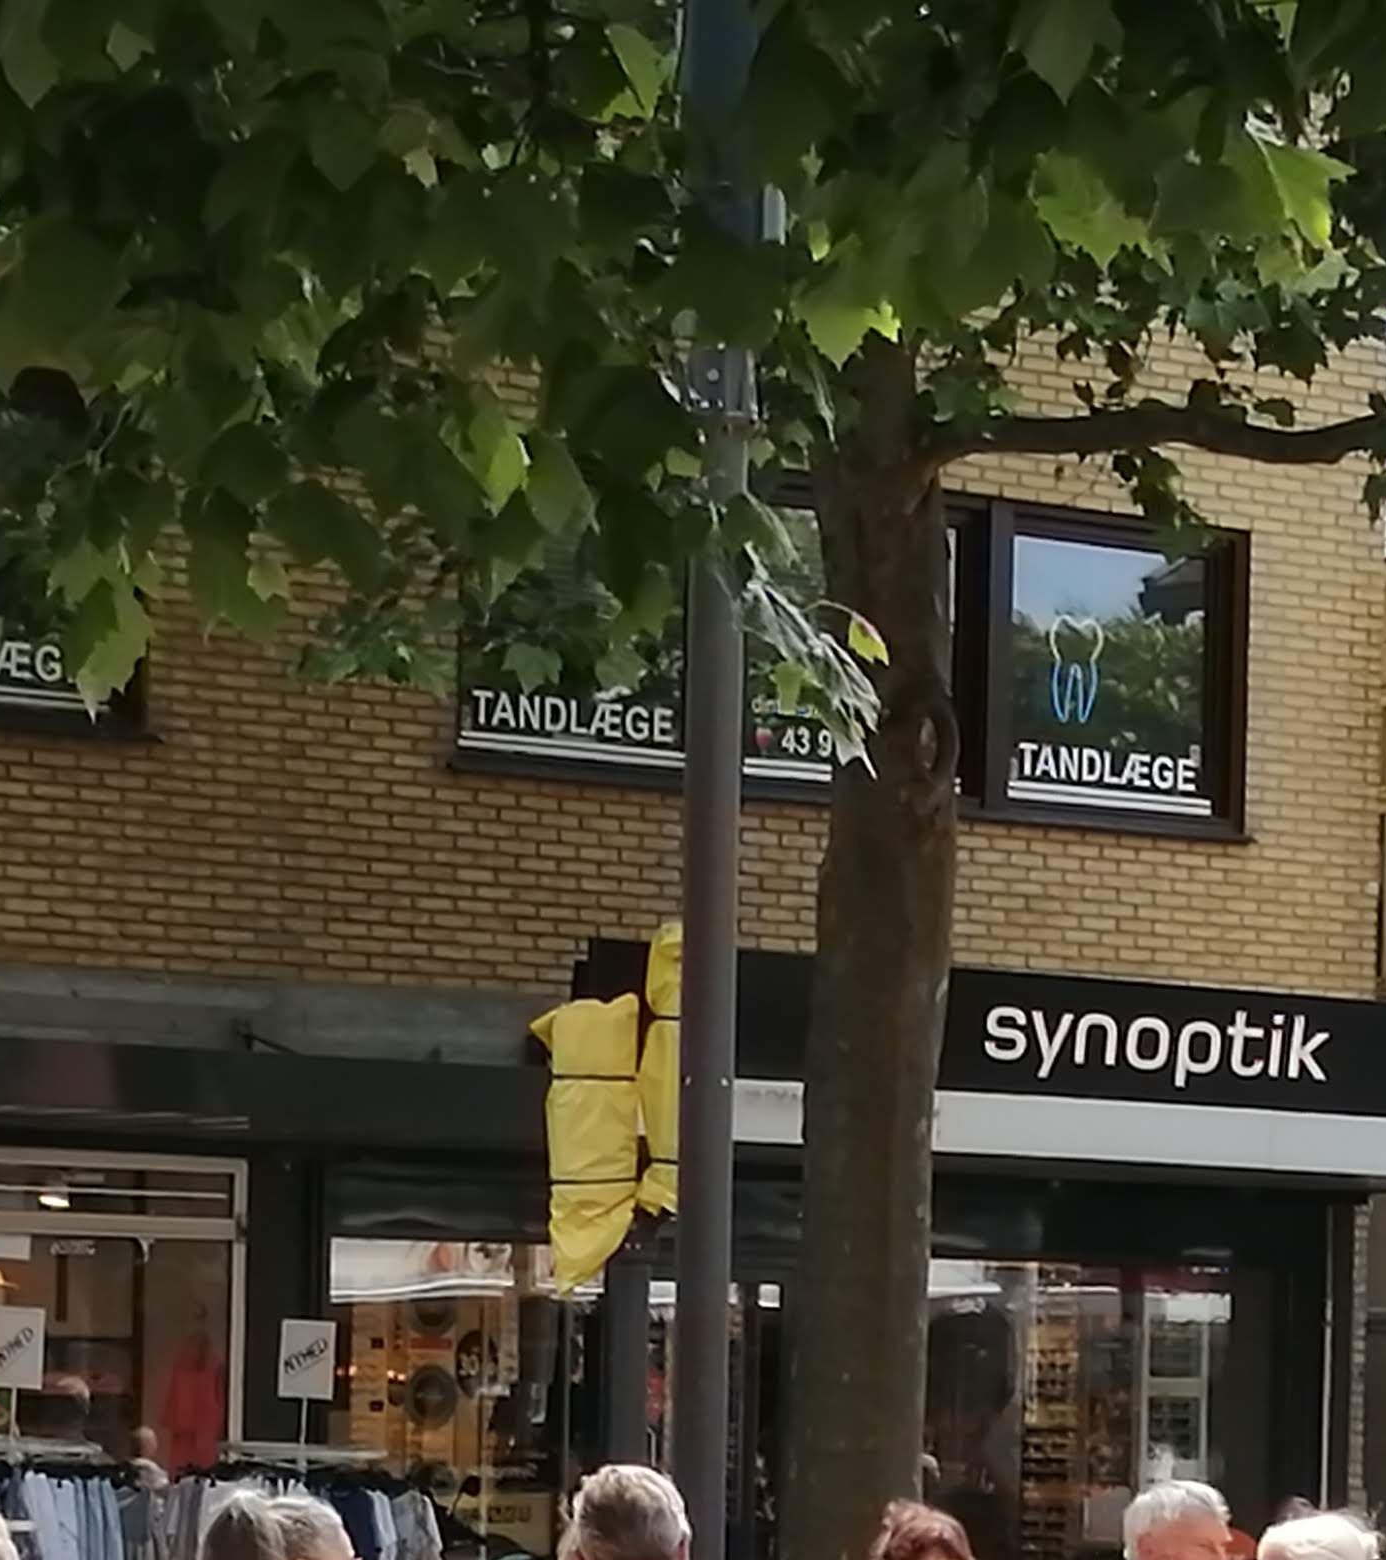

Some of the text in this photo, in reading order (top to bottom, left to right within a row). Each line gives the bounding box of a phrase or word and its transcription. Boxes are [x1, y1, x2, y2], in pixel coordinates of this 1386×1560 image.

[472, 689, 674, 743] TANDLÆGE
[781, 725, 832, 758] 43 9
[1019, 742, 1197, 792] TANDLÆGE
[984, 1005, 1330, 1088] synoptik
